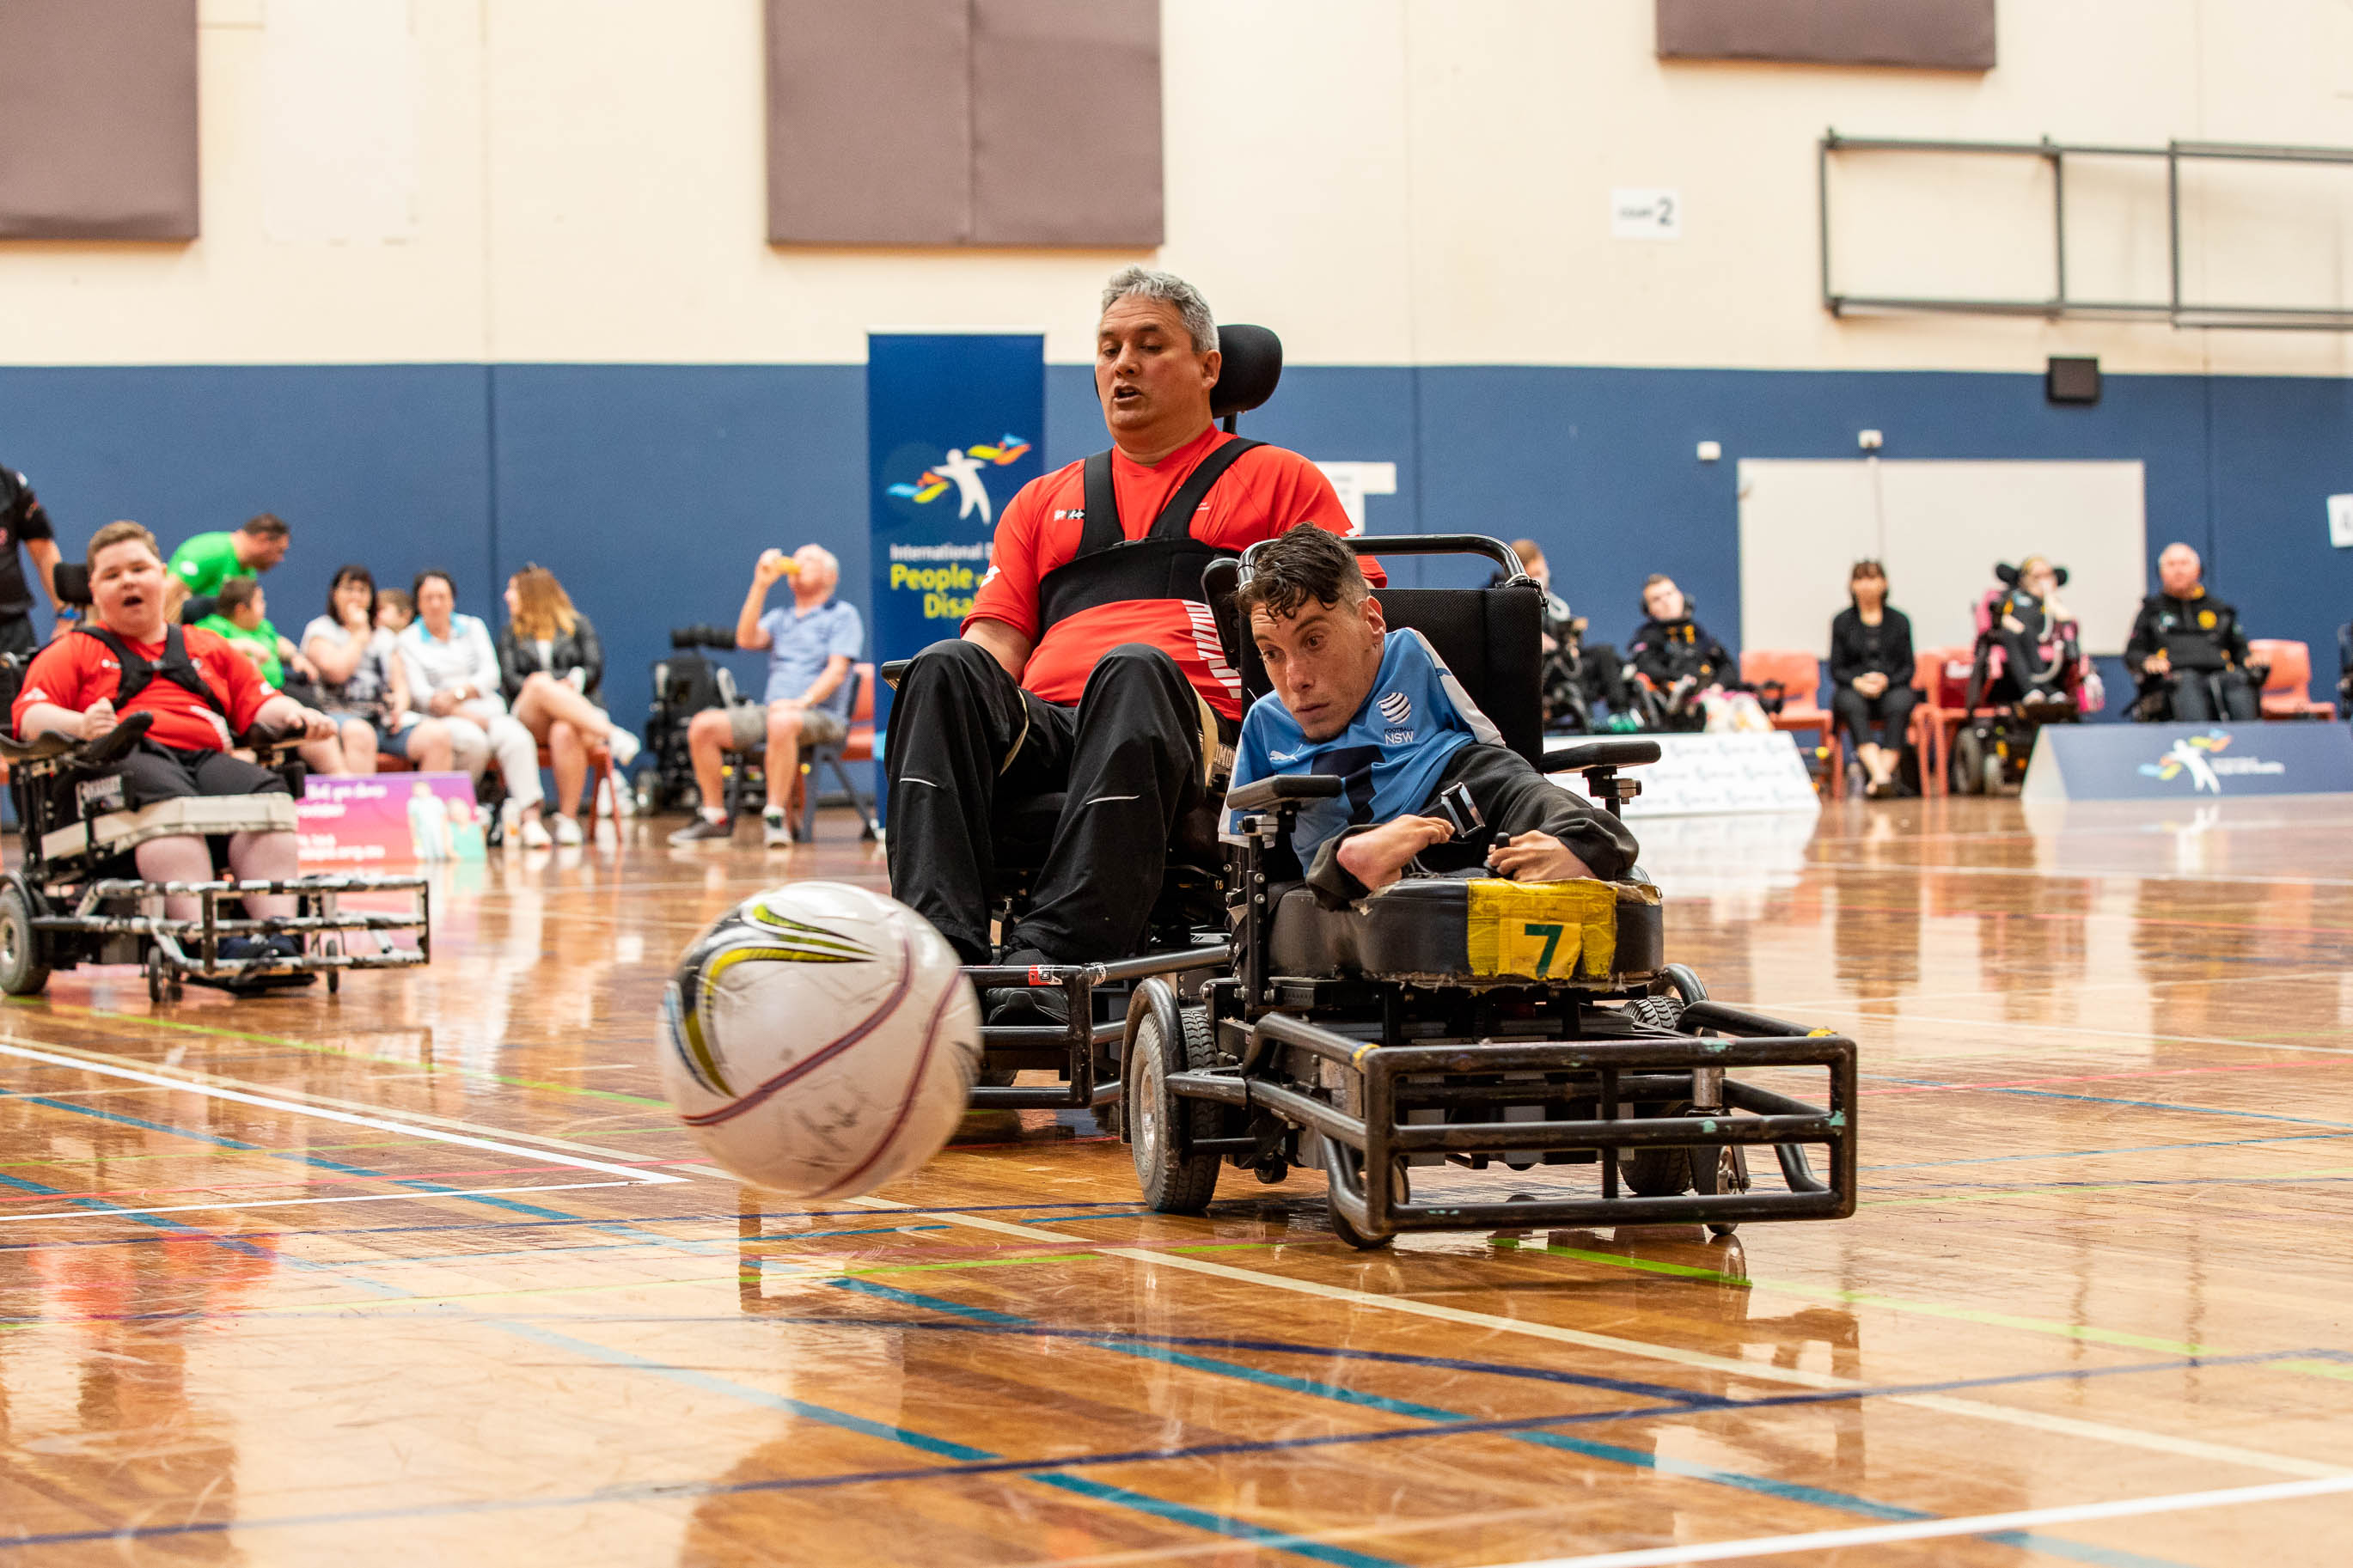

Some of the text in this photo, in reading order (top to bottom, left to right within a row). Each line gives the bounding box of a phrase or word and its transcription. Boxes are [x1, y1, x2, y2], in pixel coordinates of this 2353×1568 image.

[1657, 195, 1676, 227] 2
[889, 543, 983, 561] International
[890, 563, 974, 593] People
[924, 592, 976, 619] Disa
[1384, 731, 1414, 746] NSW
[1525, 924, 1563, 979] 7
